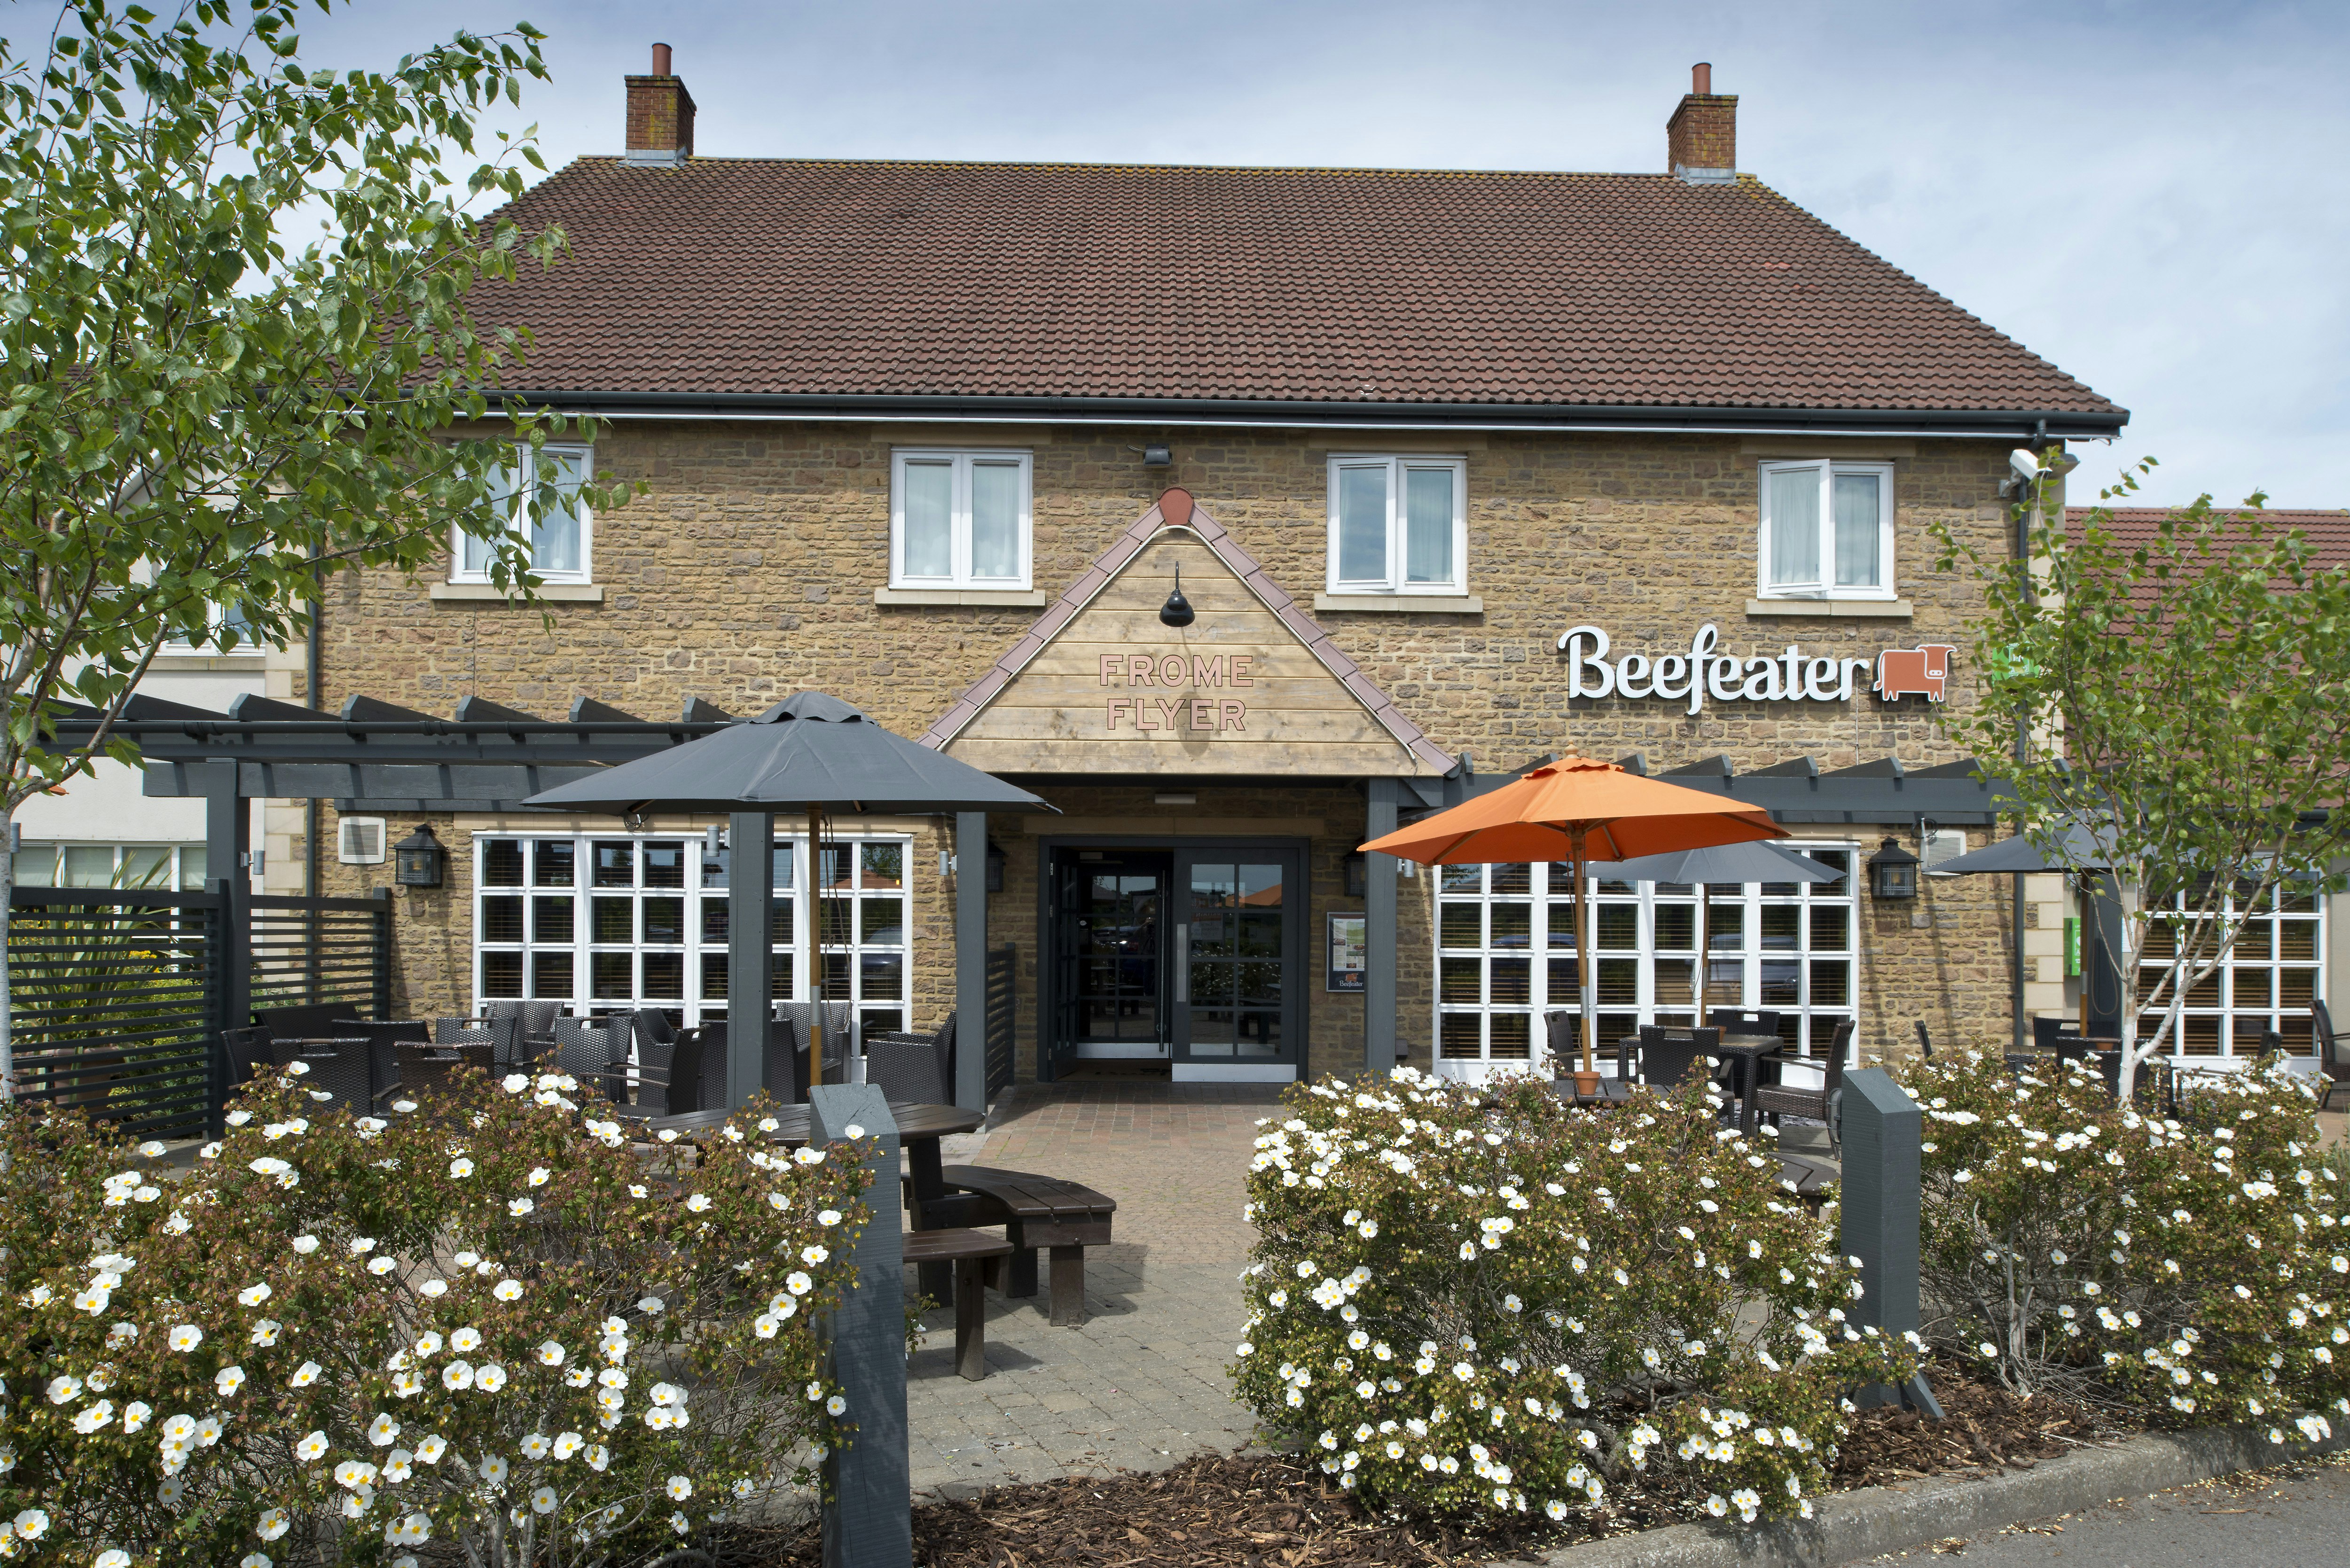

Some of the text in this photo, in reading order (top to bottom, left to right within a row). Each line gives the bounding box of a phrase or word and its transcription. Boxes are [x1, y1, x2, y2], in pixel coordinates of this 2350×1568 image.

[1100, 654, 1253, 687] FROME
[1558, 624, 1870, 715] Beefeater
[1107, 698, 1246, 731] FLYER
